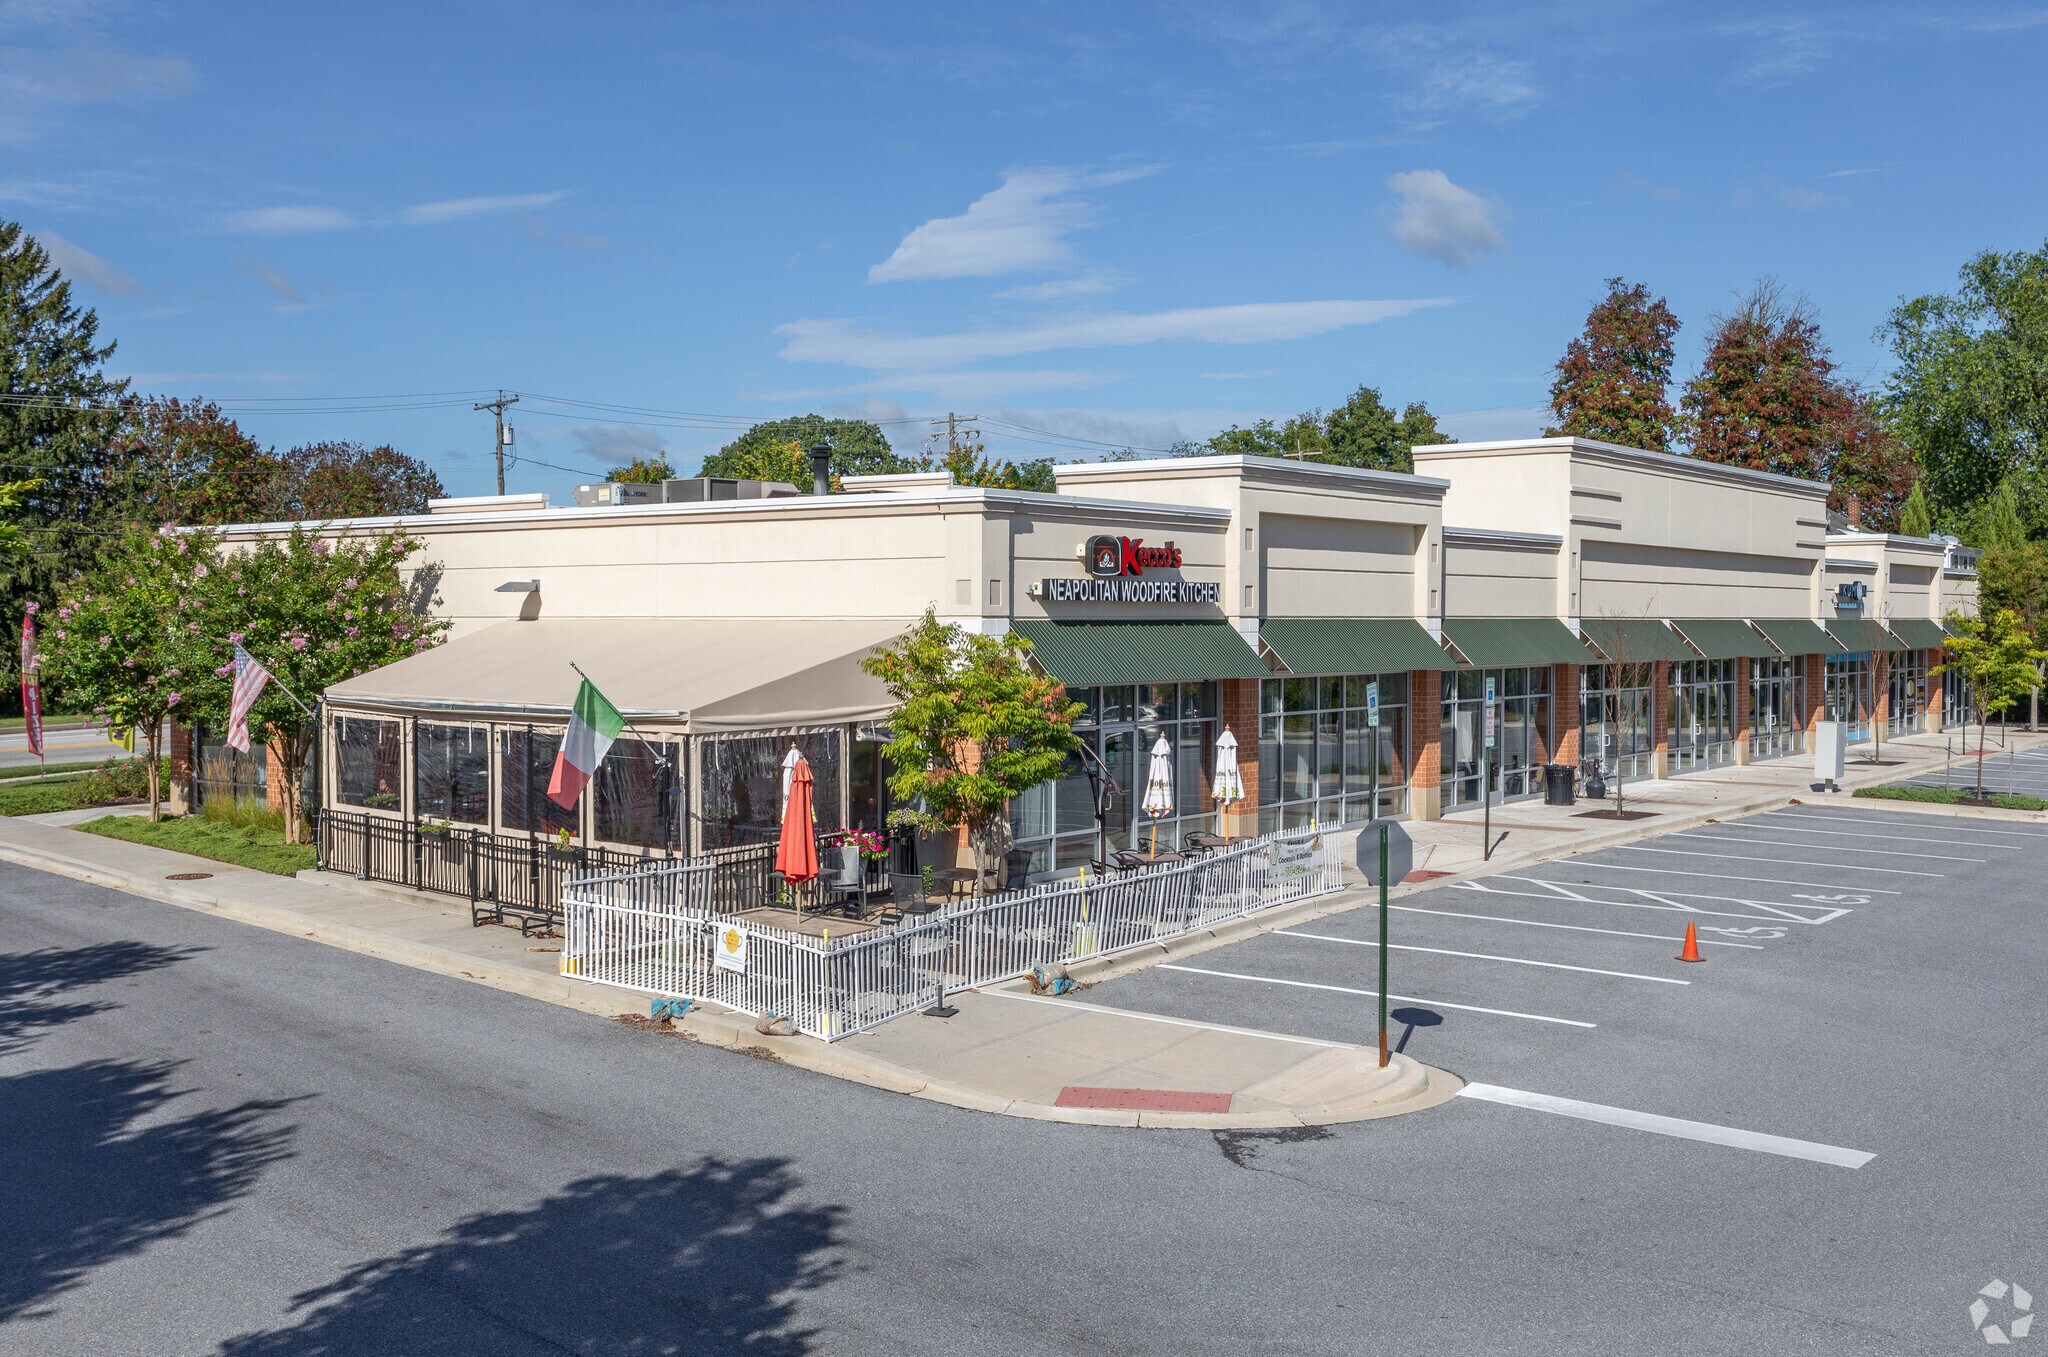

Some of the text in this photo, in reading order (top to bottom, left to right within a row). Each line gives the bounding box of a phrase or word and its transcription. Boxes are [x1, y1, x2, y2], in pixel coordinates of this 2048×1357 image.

[1121, 536, 1183, 577] Kecco's
[1050, 579, 1221, 603] NEAPOLITAN WOODFIRE KITCHEN
